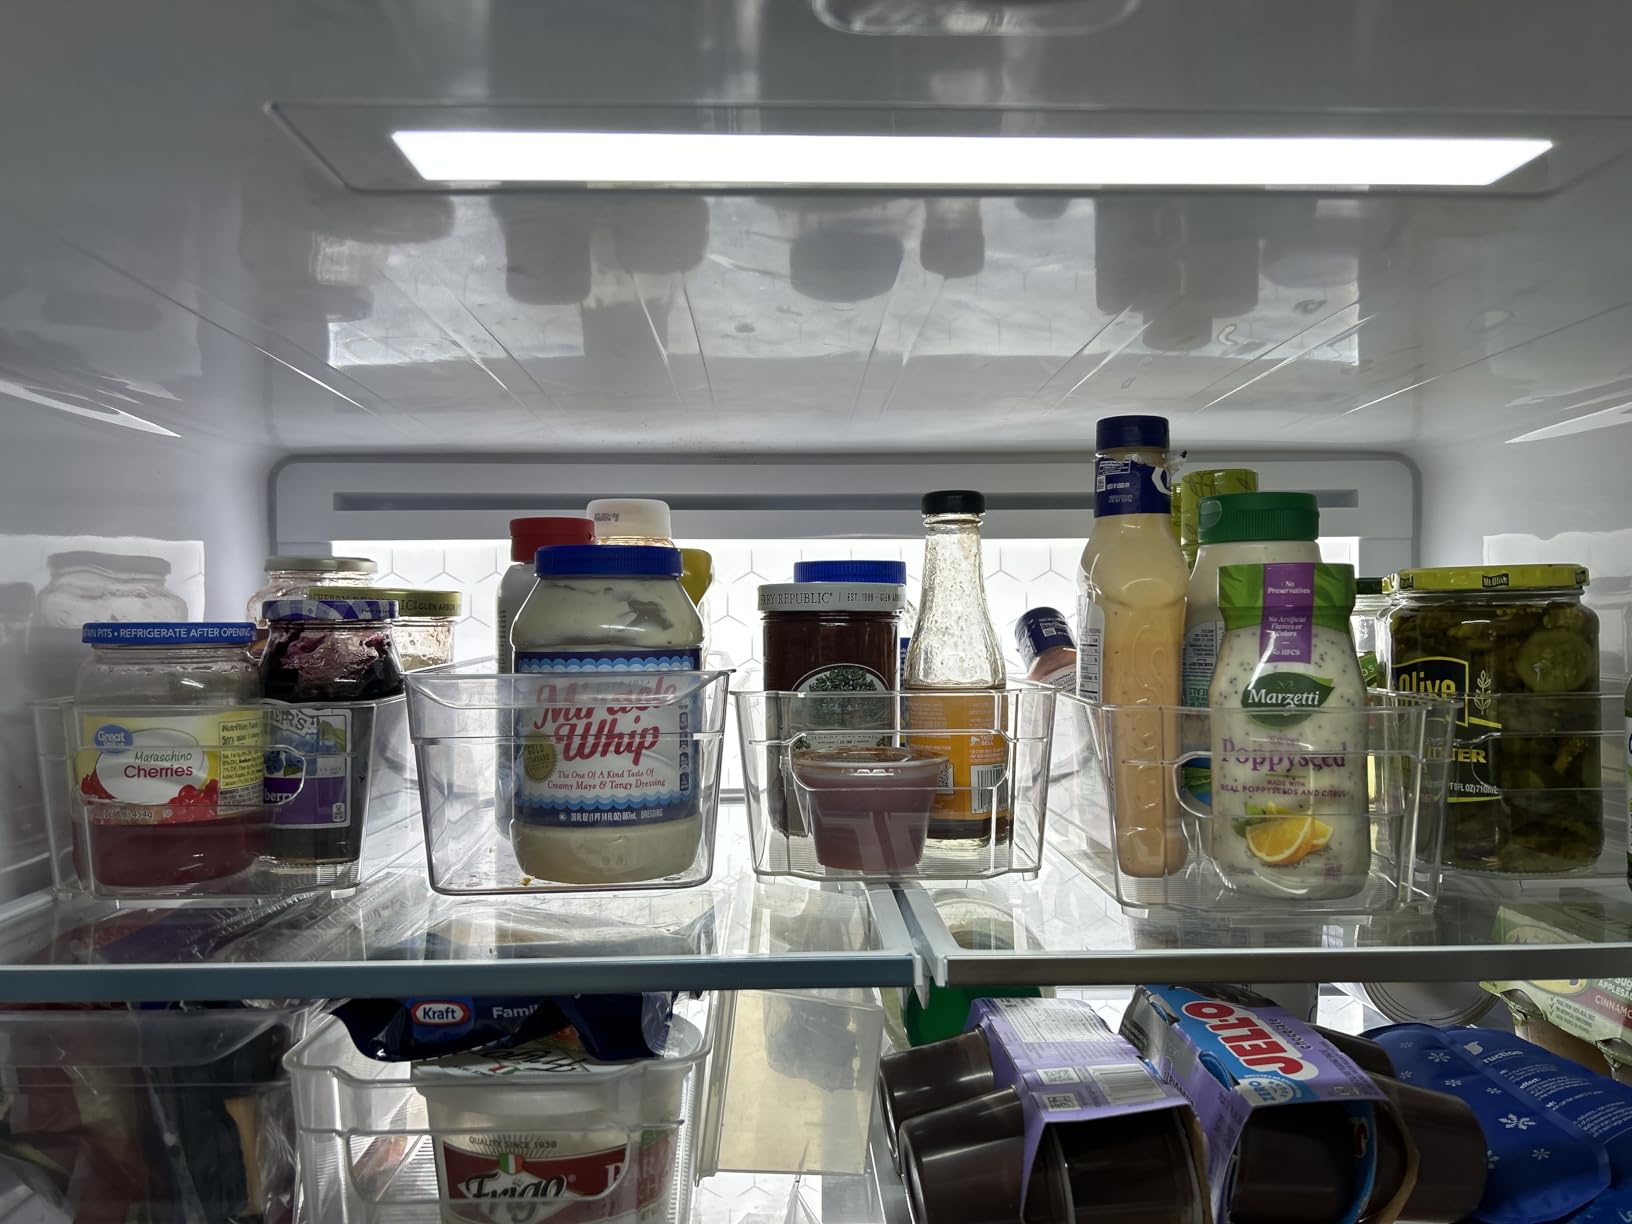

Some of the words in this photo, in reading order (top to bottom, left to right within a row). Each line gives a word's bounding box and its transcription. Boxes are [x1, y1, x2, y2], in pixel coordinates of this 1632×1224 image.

[778, 592, 830, 605] REPUBLIC
[97, 628, 113, 638] PITS
[120, 628, 188, 638] REFRIGERATE
[190, 628, 220, 638] AFTER
[221, 627, 251, 637] OPENING
[533, 676, 677, 730] Miracle
[1247, 688, 1320, 709] Marzetti
[97, 730, 126, 742] Great
[553, 714, 660, 766] Whip
[134, 750, 193, 763] Maraschino
[1222, 737, 1345, 773] Poppyseed
[123, 764, 194, 779] Cherries
[558, 770, 570, 779] The
[571, 770, 585, 779] One
[587, 770, 597, 779] Of
[598, 770, 605, 779] A
[606, 769, 625, 779] Kind
[627, 769, 645, 778] Taste
[645, 767, 655, 777] Of
[547, 780, 574, 791] Creamy
[575, 780, 597, 792] Mayo
[598, 780, 607, 790] &
[609, 780, 633, 791] Tangy
[635, 778, 666, 788] Dressing
[1221, 783, 1240, 794] REAL
[1242, 785, 1299, 796] POPPYSEEDS
[1301, 788, 1320, 797] AND
[132, 809, 153, 820] 454g
[422, 1006, 457, 1021] Kraft
[1184, 1001, 1304, 1076] JELL-O
[469, 1135, 501, 1147] QUALITY
[504, 1140, 531, 1149] SINCE
[465, 1173, 567, 1223] Frigo
